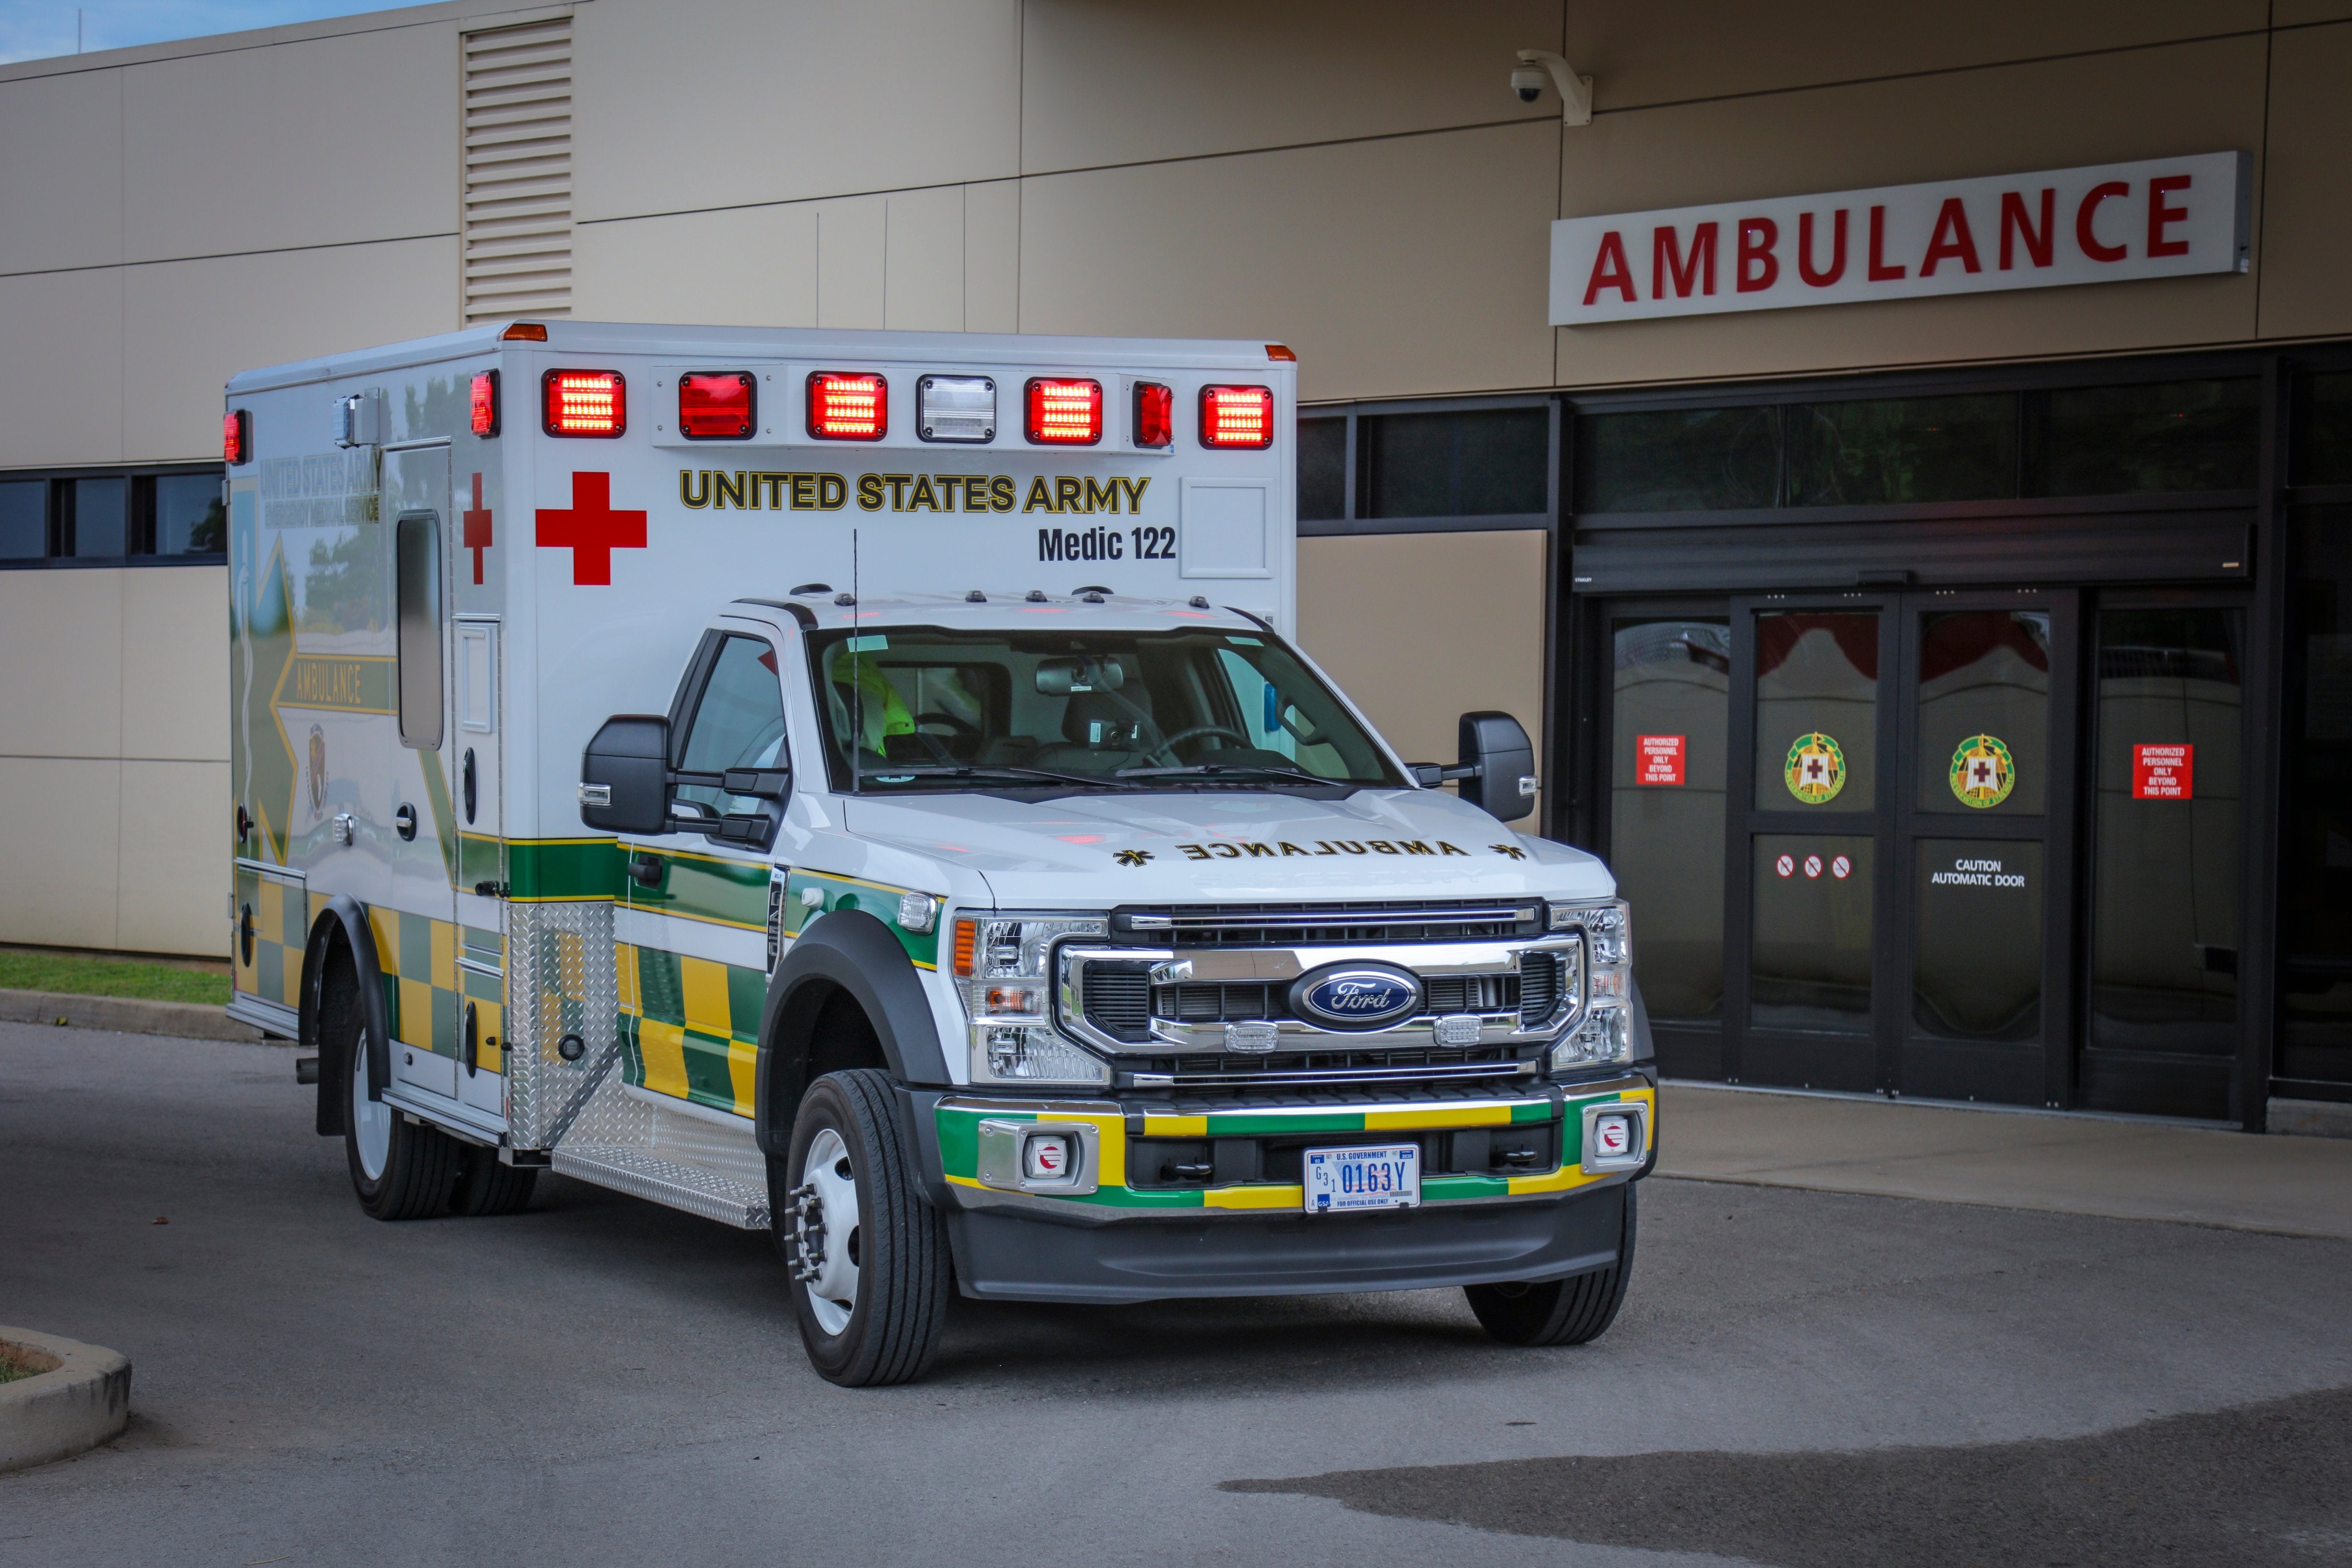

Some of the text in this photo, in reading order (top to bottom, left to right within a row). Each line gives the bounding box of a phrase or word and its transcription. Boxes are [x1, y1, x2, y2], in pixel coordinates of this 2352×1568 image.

[1582, 175, 2192, 306] AMBULANCE
[259, 457, 301, 499] UNITED
[302, 452, 345, 495] STATES
[680, 470, 1152, 514] UNITED STATES ARMY
[1038, 526, 1176, 561] Medic 122
[297, 662, 361, 704] AMBULANCE
[1644, 738, 1679, 746] AUTHORIZED
[2142, 747, 2185, 756] AUTHORIZED
[2143, 757, 2183, 766] PERSONNEL
[1645, 773, 1676, 781] THIS POINT
[2153, 767, 2172, 776] ONLY
[2148, 777, 2177, 786] BEYOND
[2144, 786, 2182, 796] THIS POINT
[1955, 859, 2001, 872] CAUTION
[1190, 868, 1484, 887] SUPER DUTY
[1931, 872, 2025, 887] AUTOMATIC DOOR
[1331, 982, 1391, 1010] Ford
[1343, 1162, 1405, 1194] 0163Y
